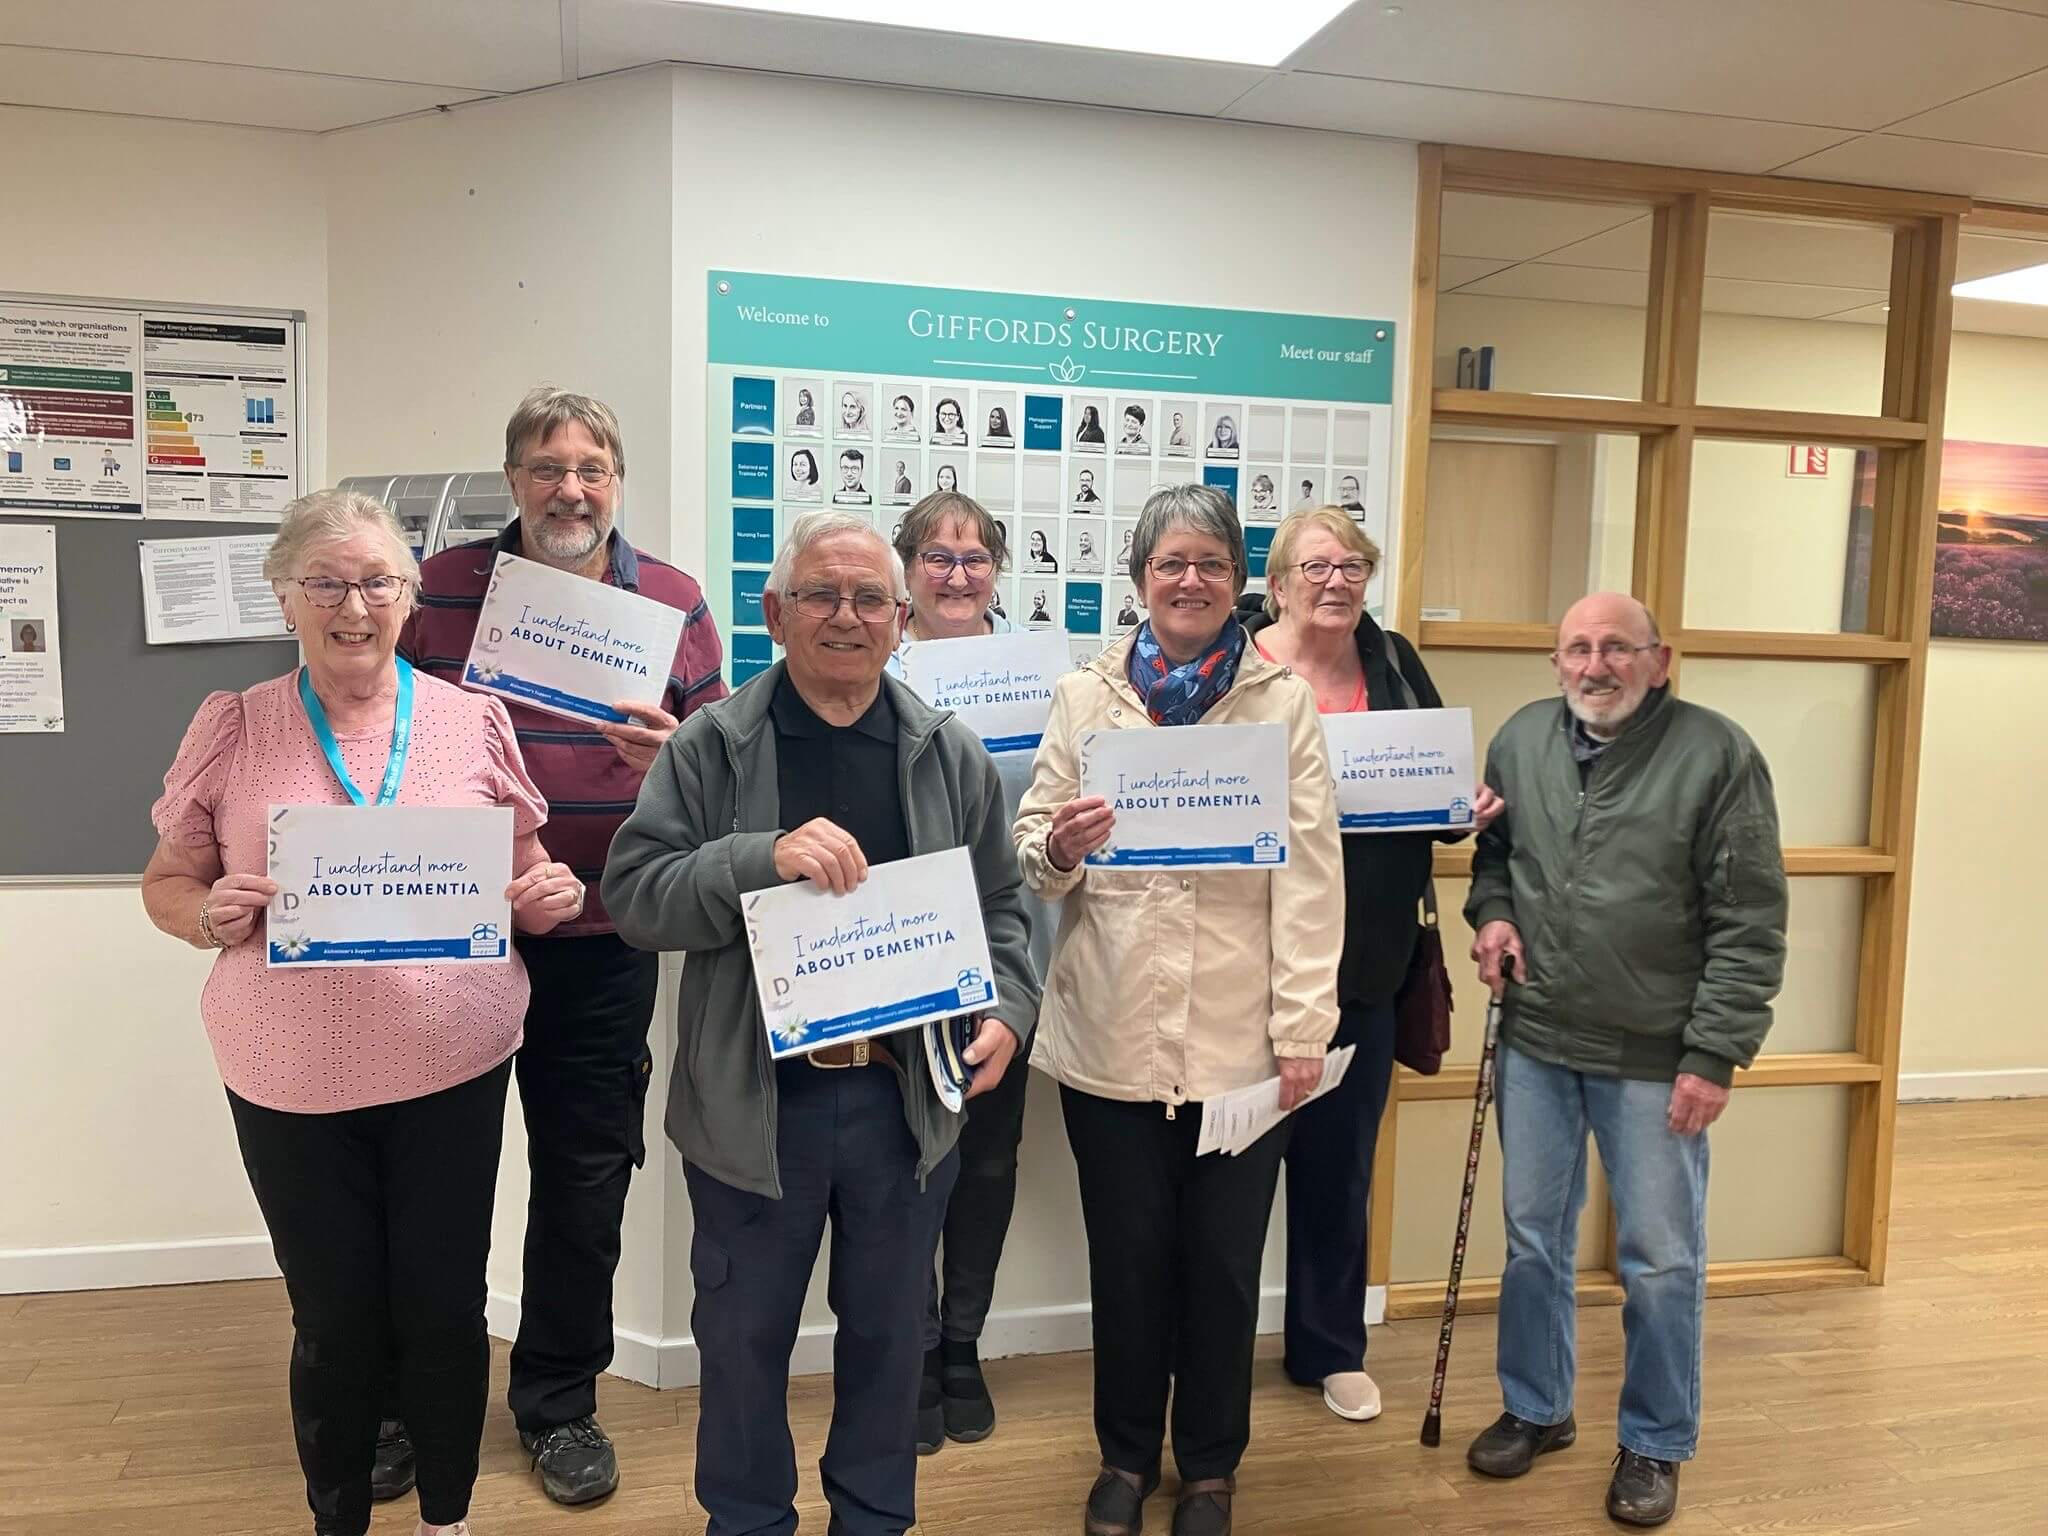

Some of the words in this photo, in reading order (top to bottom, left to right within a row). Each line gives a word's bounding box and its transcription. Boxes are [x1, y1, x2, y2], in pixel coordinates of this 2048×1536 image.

[39, 319, 66, 328] which
[69, 322, 127, 332] organisations
[737, 305, 810, 326] Welcome
[814, 314, 830, 327] to
[34, 328, 54, 336] view
[57, 330, 76, 338] your
[908, 309, 1073, 347] GIFFORDS
[1083, 322, 1224, 358] SURGERY
[1280, 344, 1314, 360] Meet
[1317, 350, 1340, 362] our
[1343, 349, 1375, 364] staff
[149, 391, 156, 400] A
[740, 402, 767, 411] Partners
[193, 414, 204, 422] 73
[0, 566, 43, 575] memory?
[519, 604, 531, 624] I
[532, 614, 611, 648] understand
[612, 637, 644, 654] more
[510, 626, 566, 651] ABOUT
[570, 644, 648, 677] DEMENTIA
[935, 677, 944, 695] I
[945, 669, 1011, 692] understand
[1014, 672, 1041, 683] more
[934, 694, 980, 708] ABOUT
[985, 689, 1052, 704] DEMENTIA
[1342, 750, 1352, 767] I
[1352, 744, 1415, 764] understand
[1417, 750, 1445, 759] more
[1118, 773, 1127, 794] I
[1131, 767, 1210, 792] understand
[1215, 774, 1250, 786] more
[1341, 768, 1385, 780] ABOUT
[1390, 766, 1455, 778] DEMENTIA
[1114, 796, 1171, 810] ABOUT
[1176, 794, 1261, 809] DEMENTIA
[312, 856, 323, 879] I
[328, 851, 422, 878] understand
[427, 862, 468, 873] more
[307, 883, 375, 896] ABOUT
[382, 882, 480, 896] DEMENTIA
[283, 892, 300, 910] D
[793, 934, 806, 959] I
[809, 912, 897, 952] understand
[901, 911, 939, 930] more
[795, 952, 857, 978] ABOUT
[864, 930, 956, 962] DEMENTIA
[773, 977, 790, 997] D
